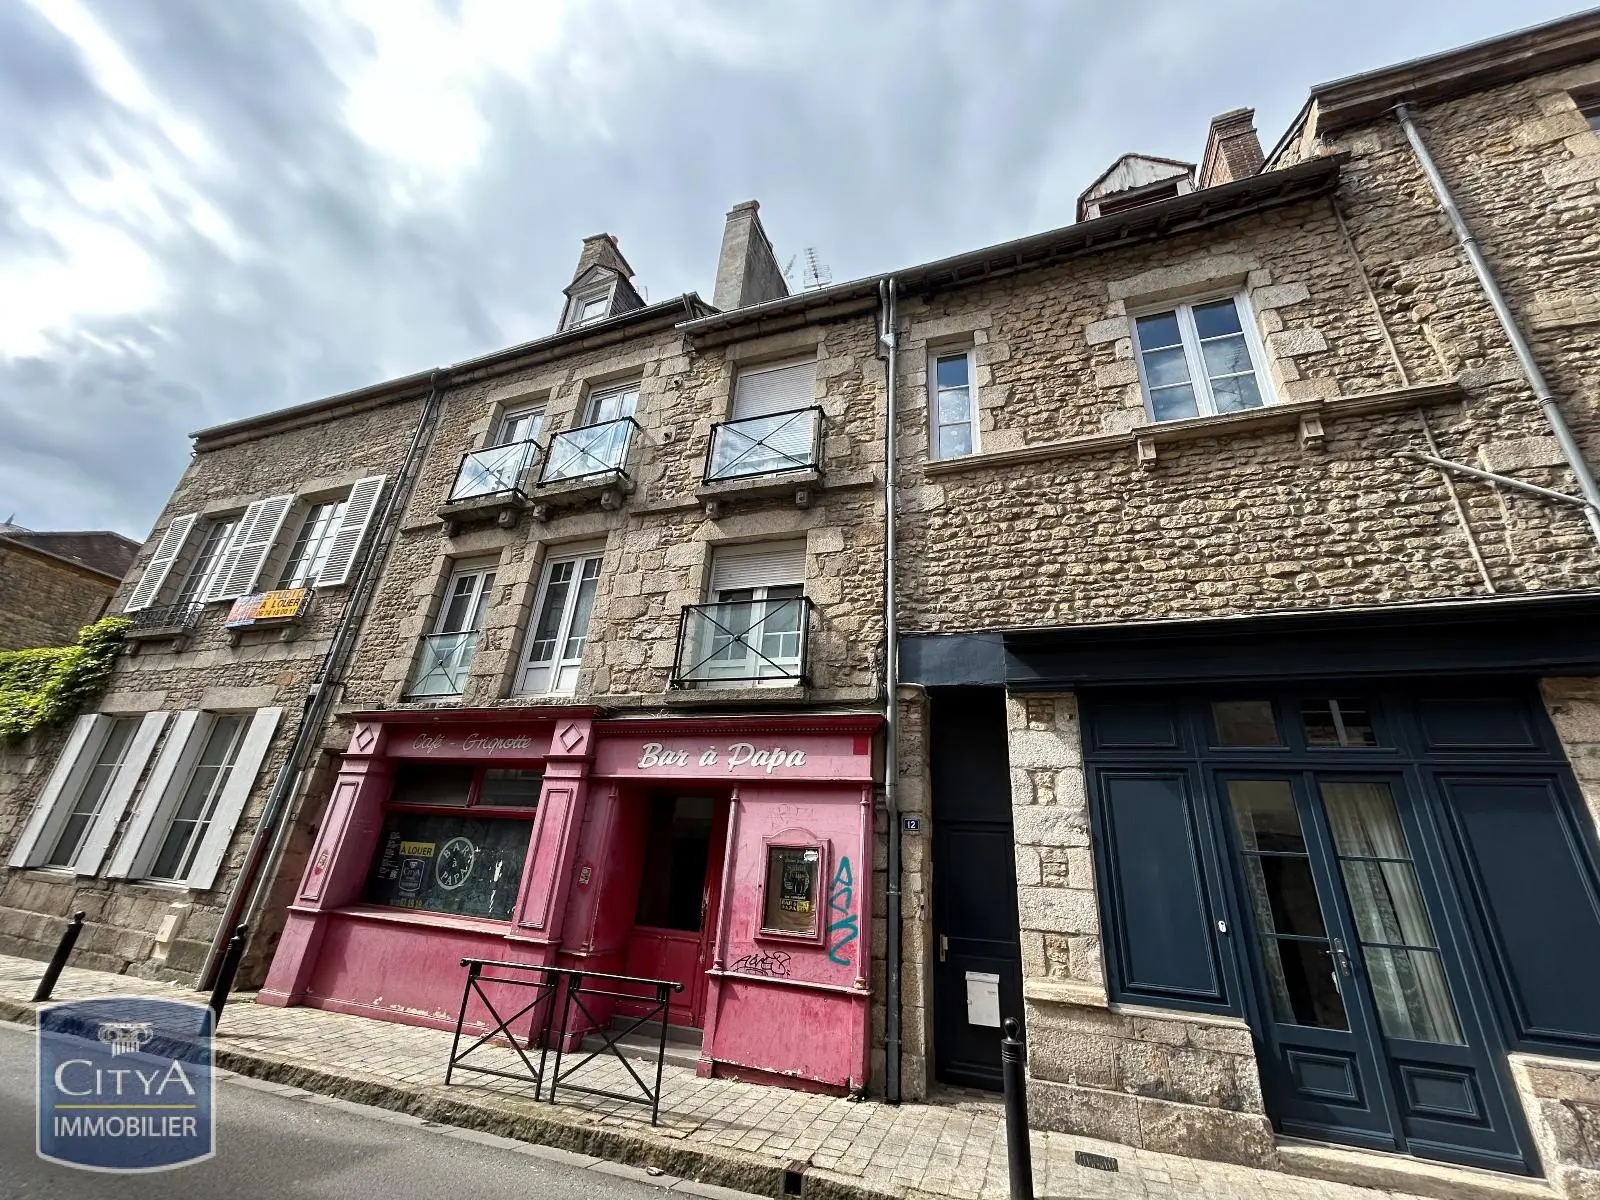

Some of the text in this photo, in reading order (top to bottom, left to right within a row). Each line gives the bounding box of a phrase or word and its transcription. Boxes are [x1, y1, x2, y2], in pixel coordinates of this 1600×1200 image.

[271, 599, 300, 608] LOUER
[413, 733, 445, 754] Café
[462, 733, 532, 756] Grignotte
[638, 742, 806, 774] Bar à Papa
[407, 845, 432, 856] LOUER
[443, 842, 470, 859] BAR
[452, 858, 458, 868] à
[440, 866, 469, 886] PAPA
